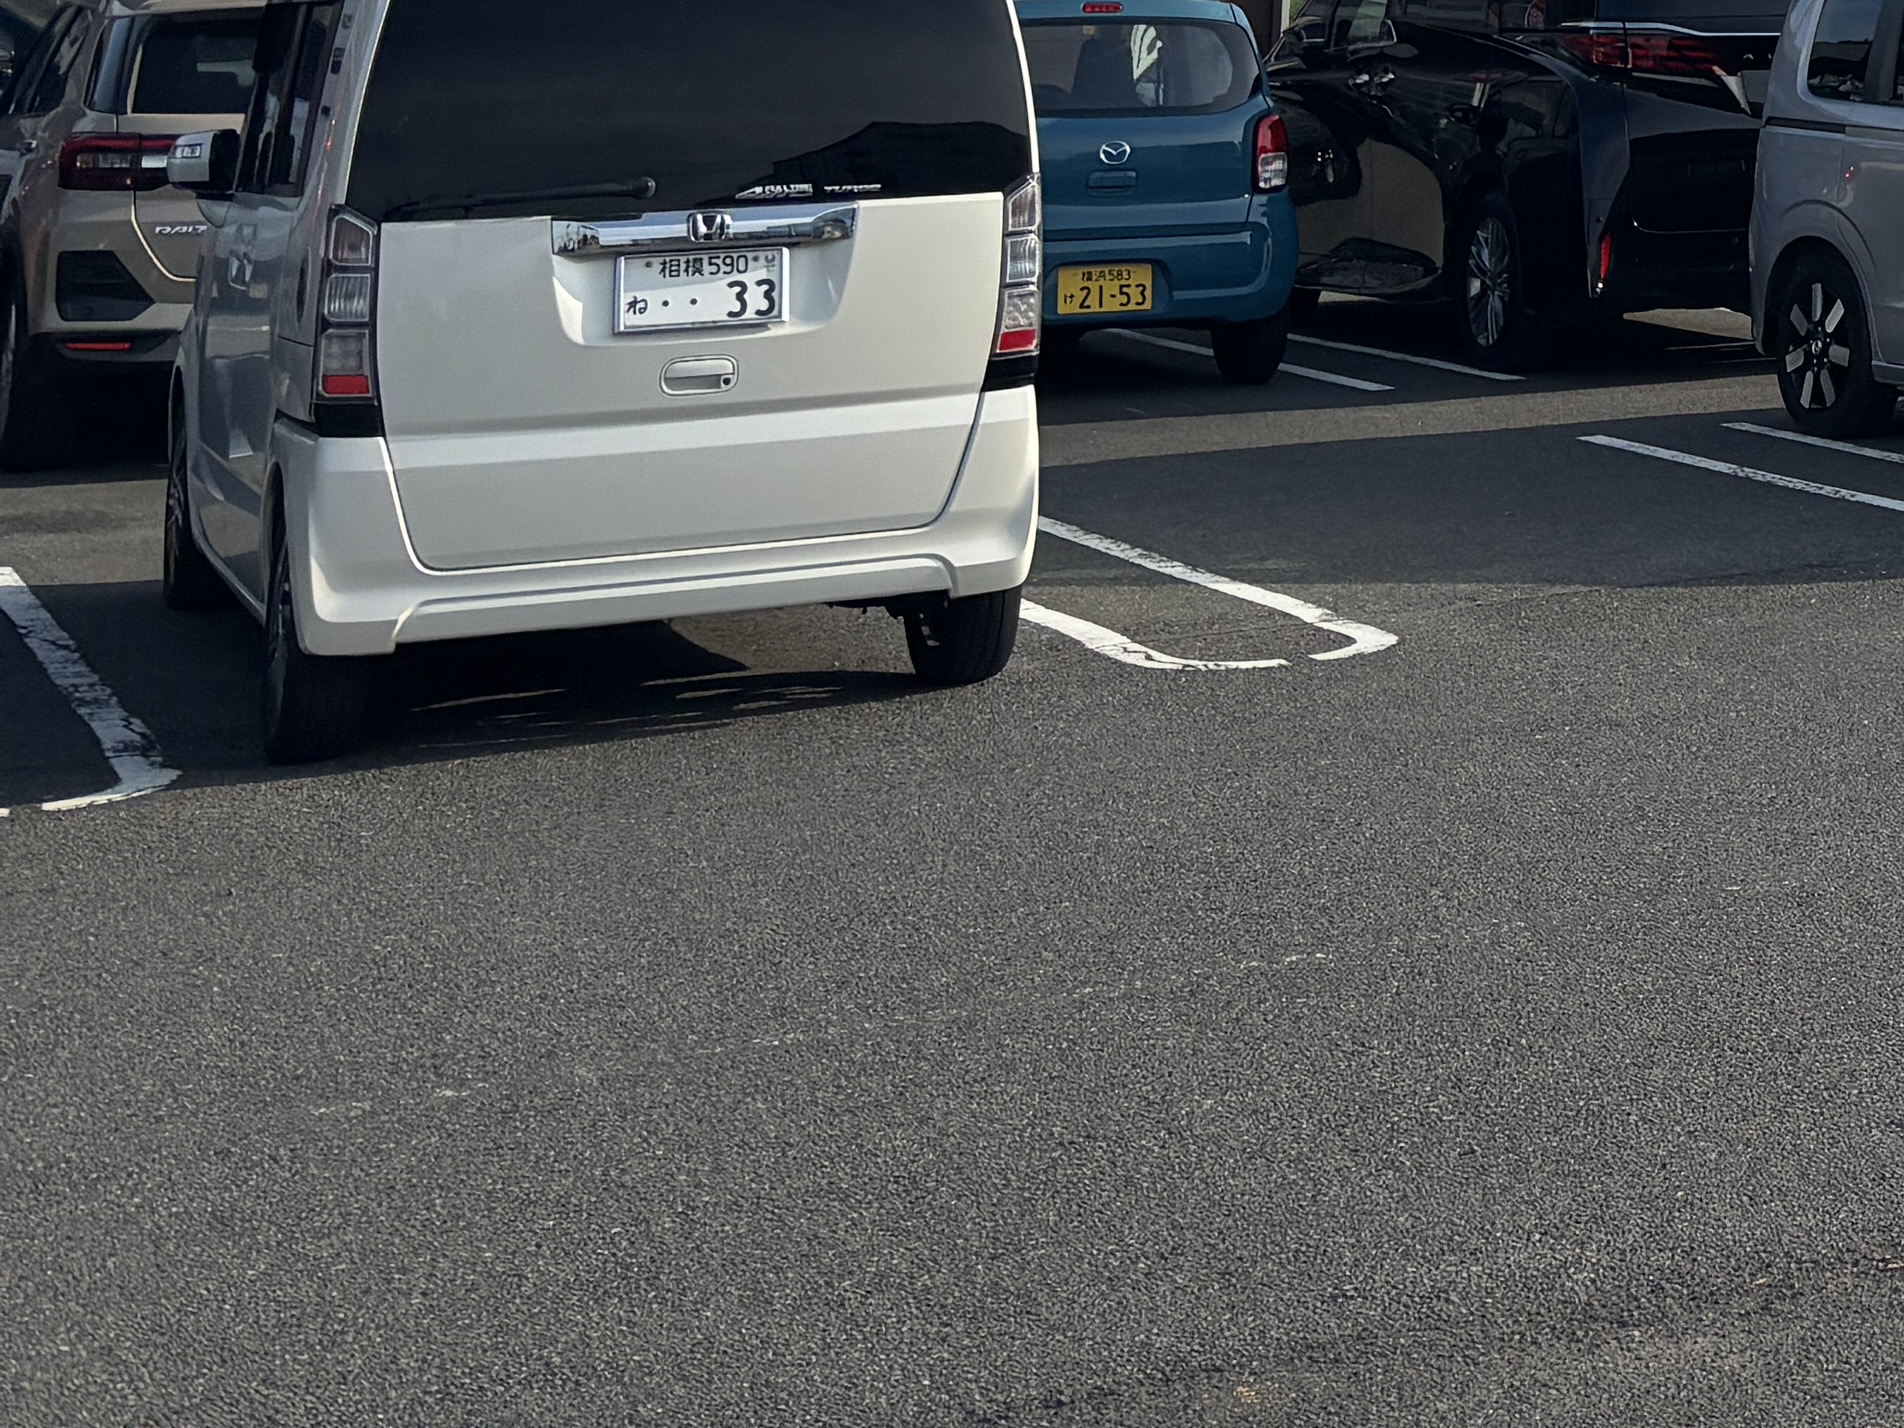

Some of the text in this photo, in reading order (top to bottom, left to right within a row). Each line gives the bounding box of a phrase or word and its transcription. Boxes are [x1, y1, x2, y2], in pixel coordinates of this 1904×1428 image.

[659, 254, 749, 278] 相模590
[626, 278, 776, 318] ね 33
[1079, 283, 1147, 309] 21-53
